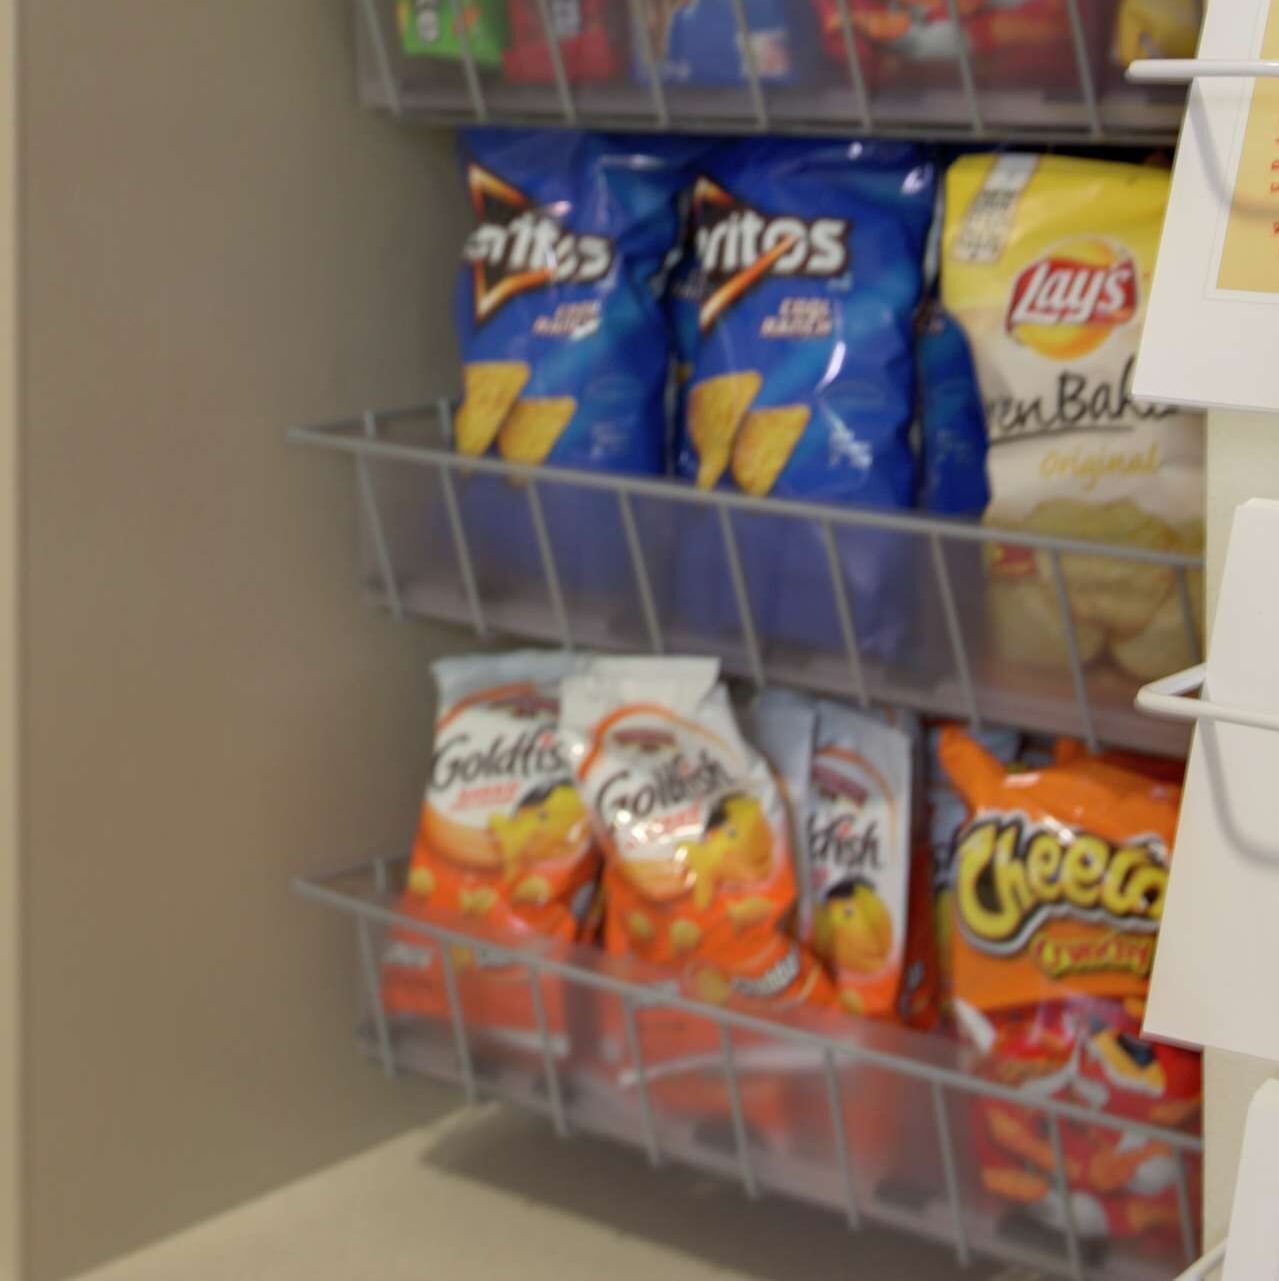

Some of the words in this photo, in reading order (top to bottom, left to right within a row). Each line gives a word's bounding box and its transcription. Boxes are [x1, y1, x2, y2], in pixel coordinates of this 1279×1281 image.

[462, 211, 612, 279] ritos
[696, 209, 848, 275] ritos
[1007, 254, 1134, 327] Lay's
[431, 722, 572, 791] Goldfis
